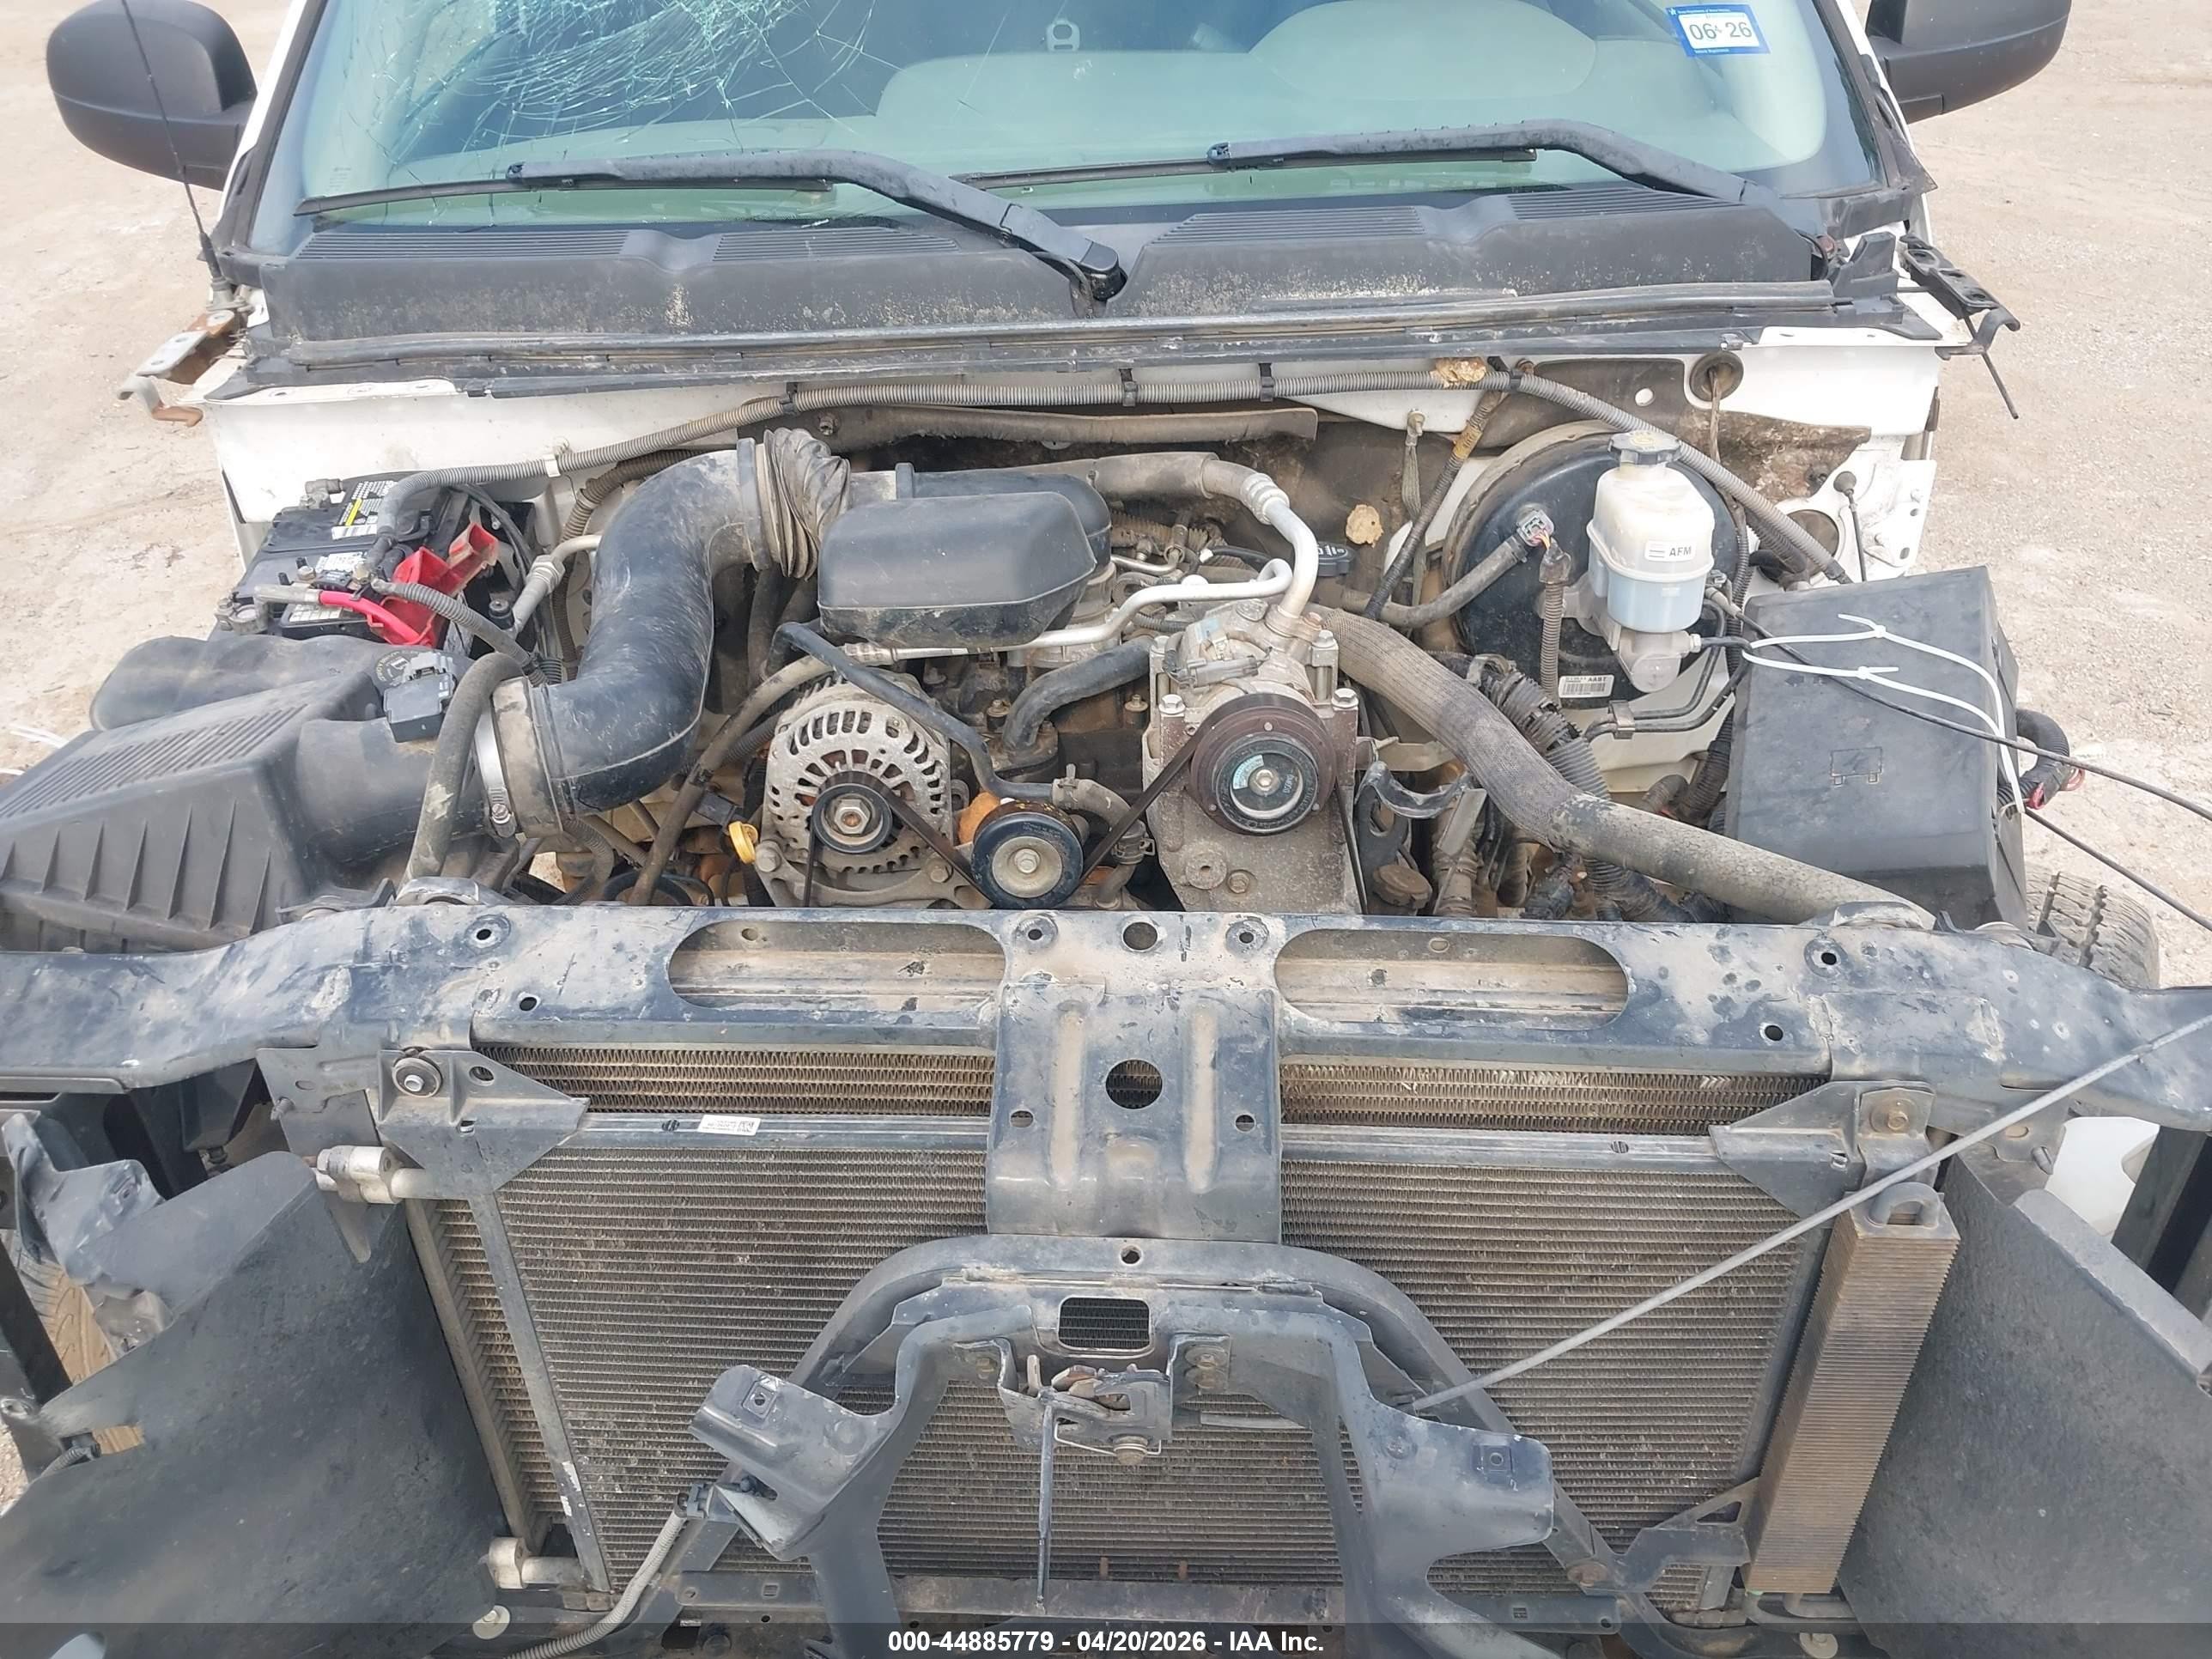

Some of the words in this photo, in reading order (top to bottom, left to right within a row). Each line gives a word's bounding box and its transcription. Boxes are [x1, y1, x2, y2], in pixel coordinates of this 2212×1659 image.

[1688, 22, 1717, 40] 06
[1725, 21, 1753, 38] 26
[1669, 545, 1692, 556] AFM
